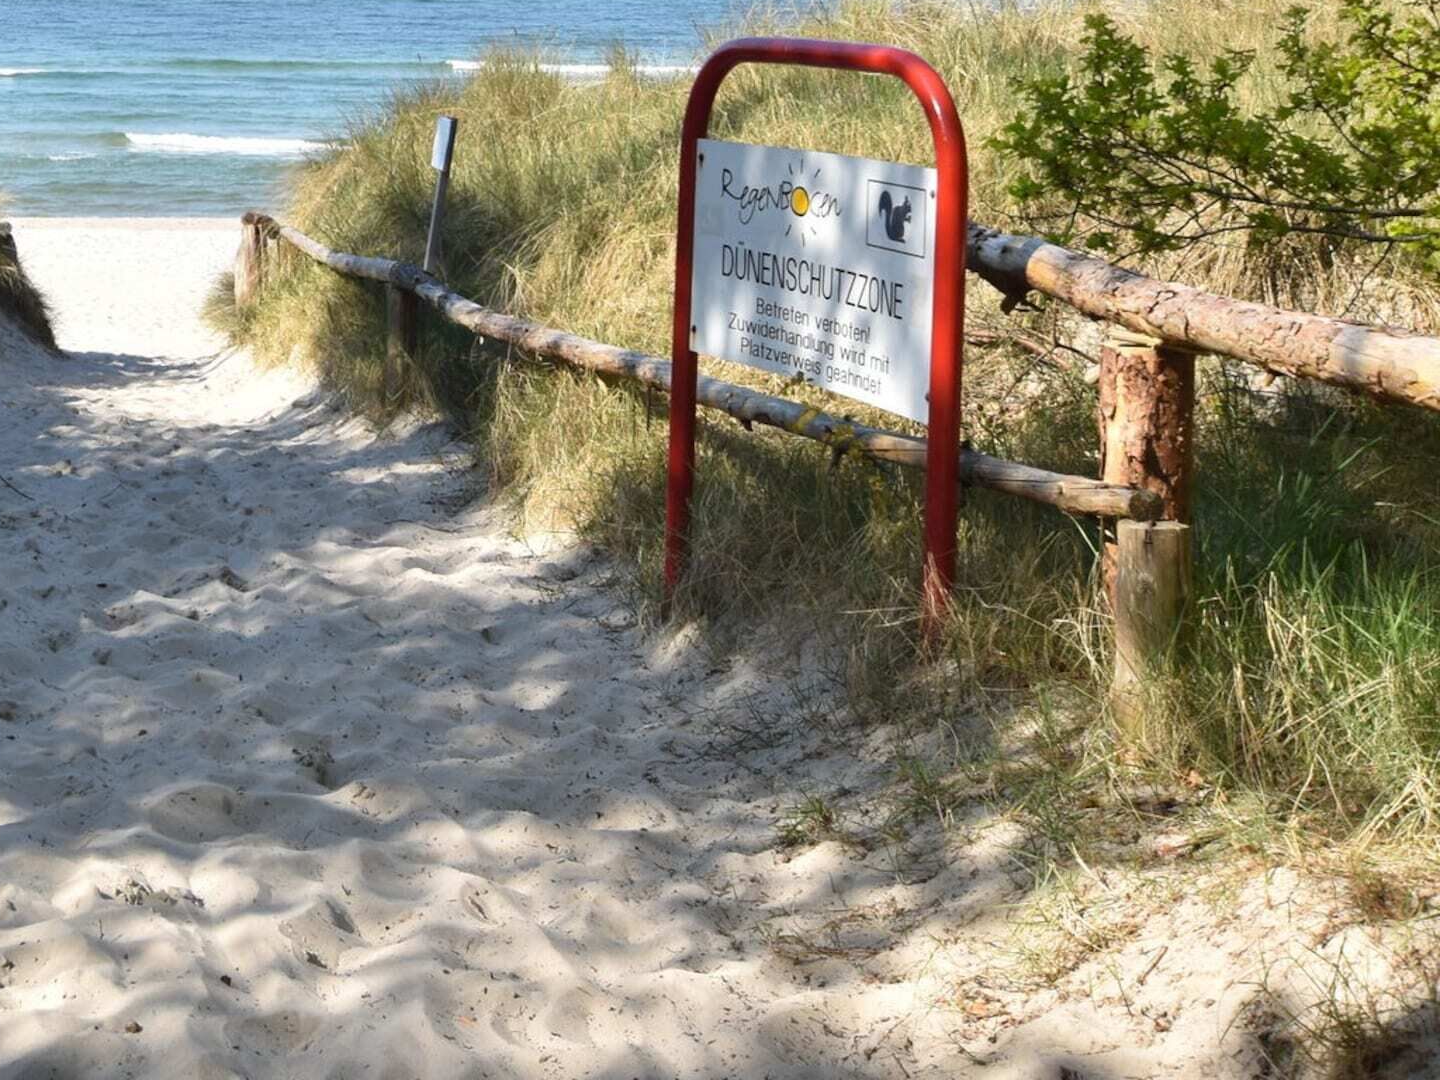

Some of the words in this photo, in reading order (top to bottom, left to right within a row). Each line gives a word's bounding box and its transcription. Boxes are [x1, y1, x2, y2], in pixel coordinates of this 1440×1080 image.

[722, 242, 903, 319] DÜNENSCHUTZZONE
[728, 312, 834, 359] Zuwiderhandlung
[840, 344, 866, 366] wird
[870, 356, 890, 375] mit
[756, 297, 809, 326] Betreten
[815, 316, 871, 345] verboten!
[740, 337, 822, 376] Platzverweis
[826, 363, 881, 395] geahndet
